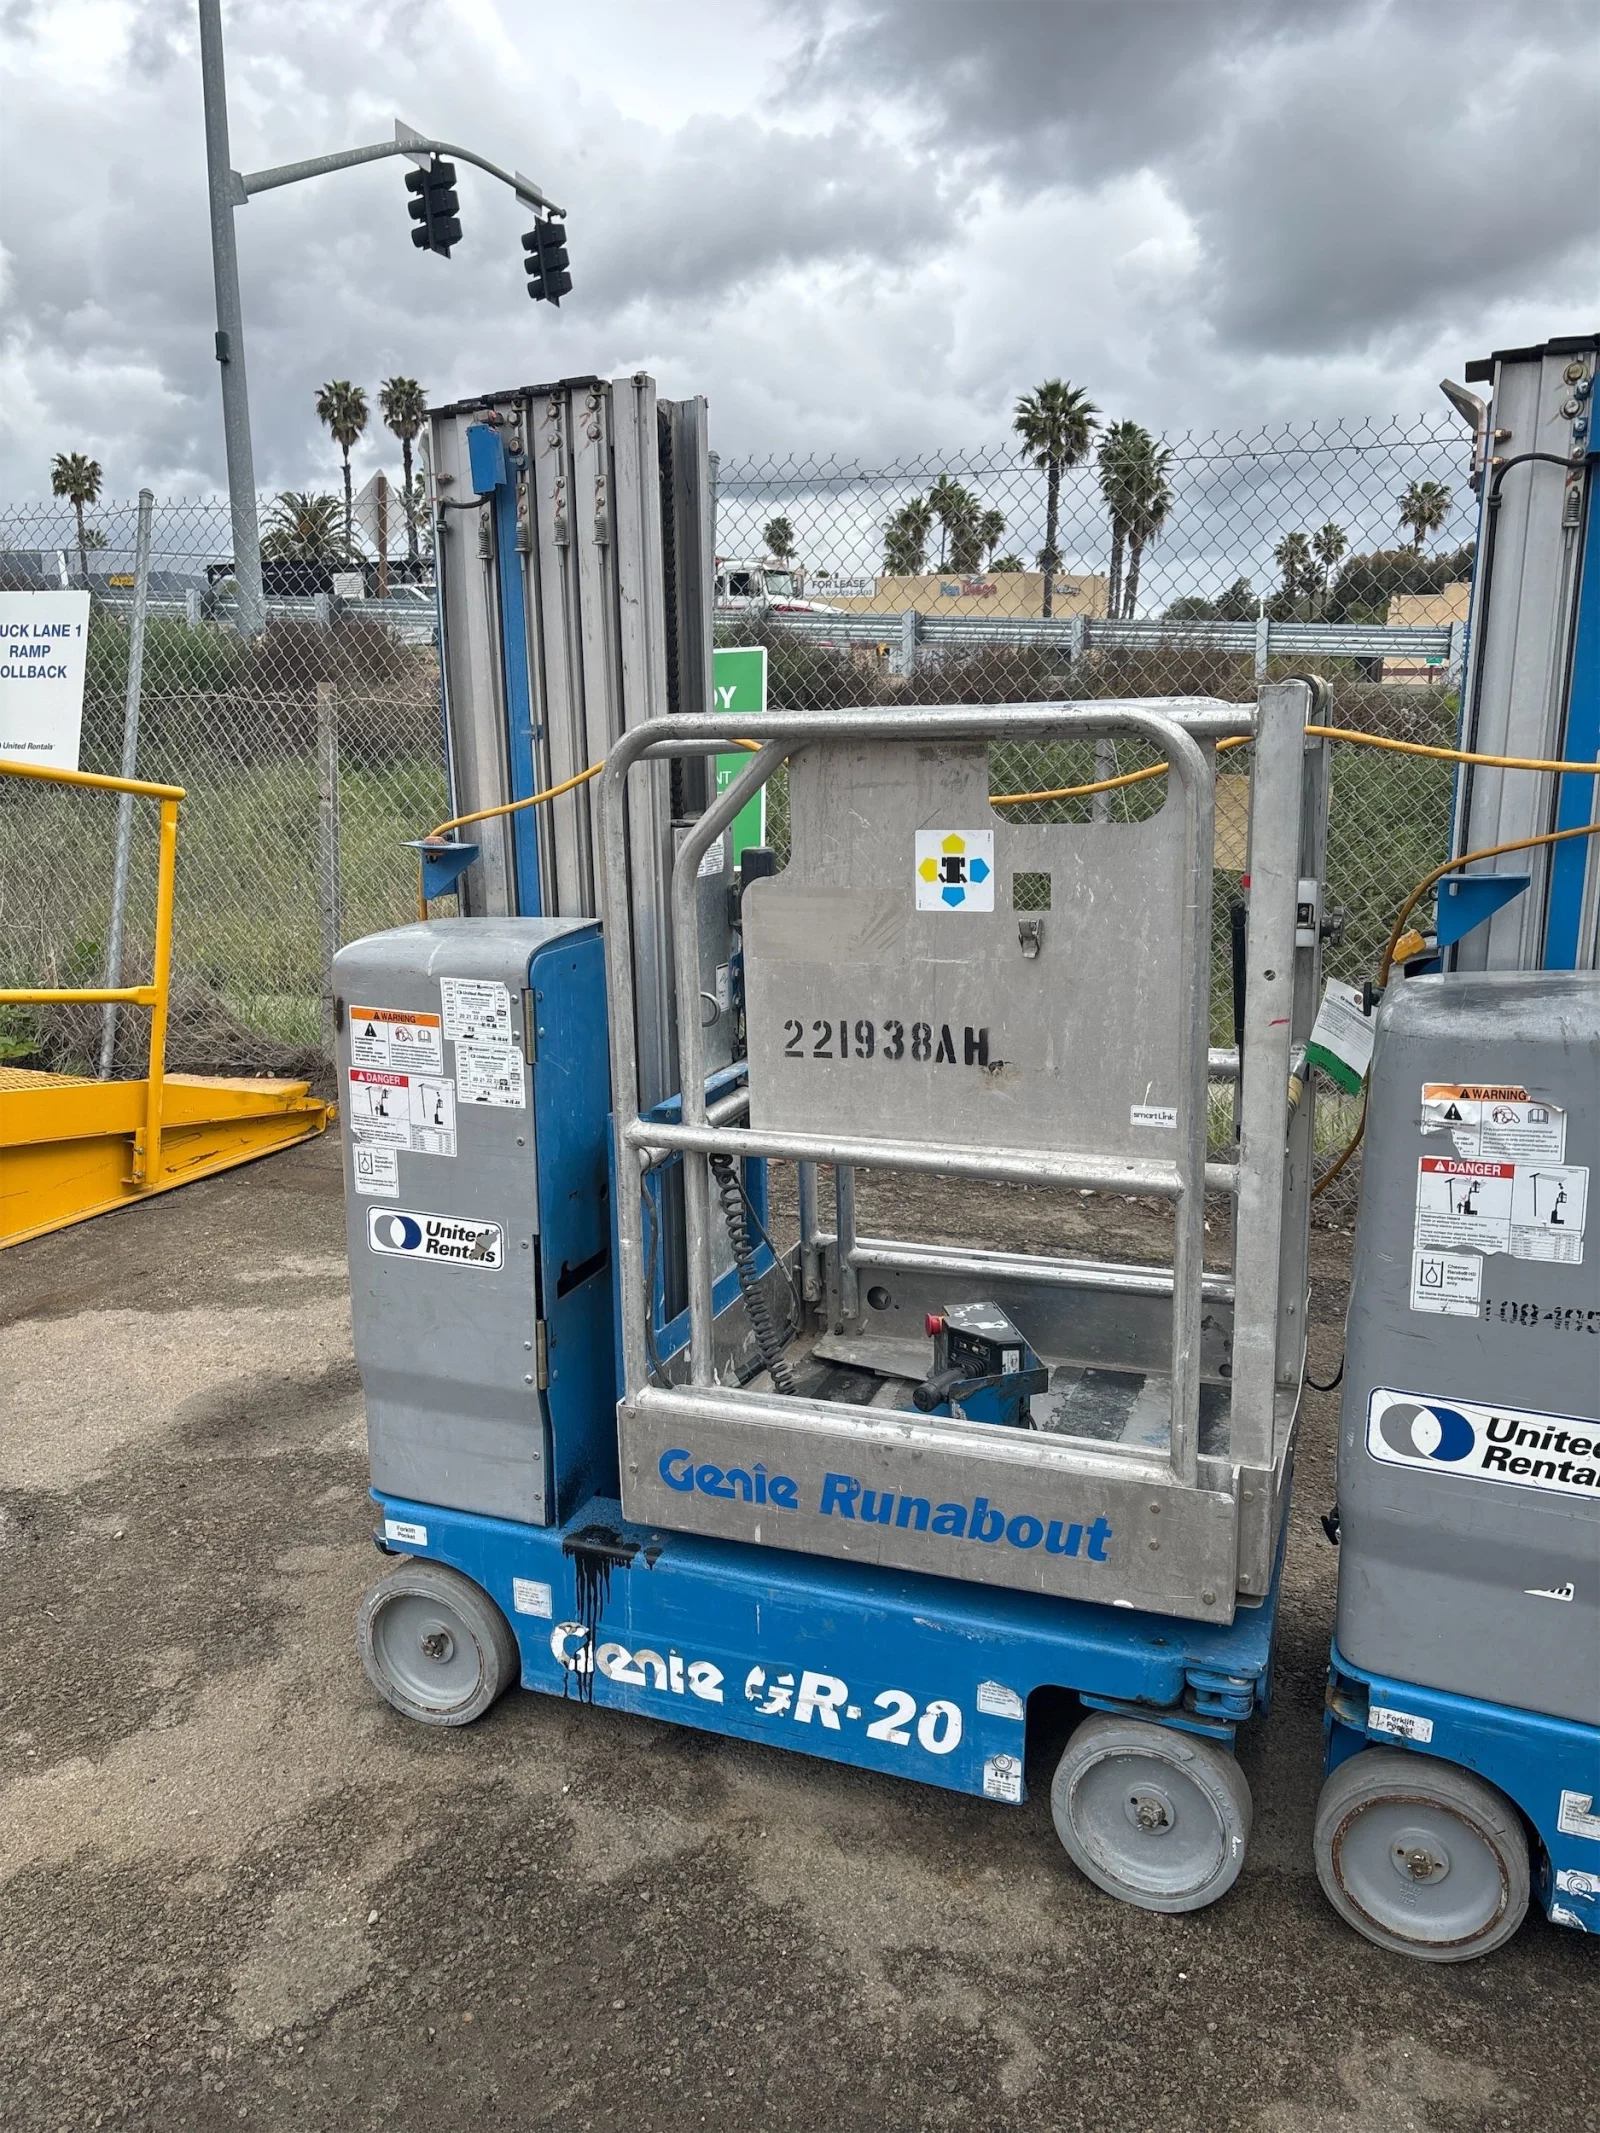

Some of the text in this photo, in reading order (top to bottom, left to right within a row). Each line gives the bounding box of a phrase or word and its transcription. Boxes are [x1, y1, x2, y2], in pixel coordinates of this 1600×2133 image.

[812, 580, 866, 588] FOR LEASE
[962, 580, 998, 598] Diego
[33, 624, 70, 638] LANE
[75, 624, 82, 638] 1
[10, 645, 51, 658] RAMP
[0, 665, 67, 678] OLLBACK
[2, 742, 54, 750] United Rentals
[380, 1012, 416, 1023] WARNING
[784, 1018, 990, 1067] 221938AH
[366, 1072, 400, 1085] DANGER
[1472, 1088, 1527, 1100] WARNING
[1448, 1162, 1500, 1176] DANGER
[658, 1448, 1114, 1562] Genie Runabout
[396, 1525, 416, 1533] Forklift
[398, 1532, 416, 1540] Pocket
[550, 1621, 963, 1754] Genie GR-20
[1386, 1714, 1415, 1726] Forklift
[1386, 1722, 1413, 1733] Pocket
